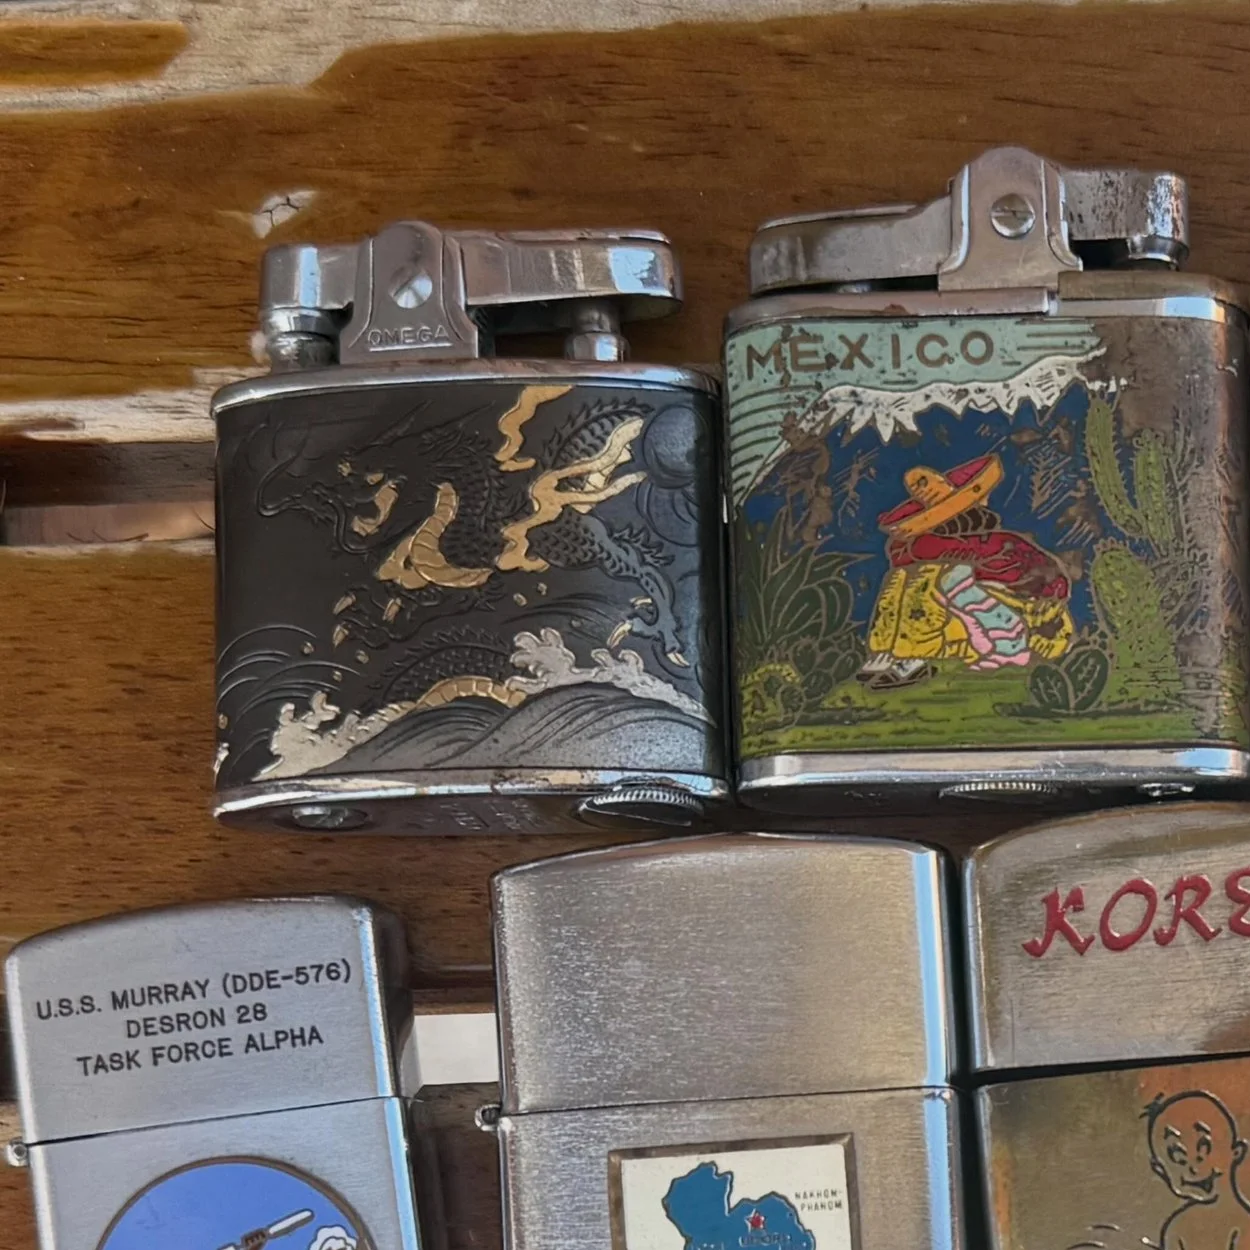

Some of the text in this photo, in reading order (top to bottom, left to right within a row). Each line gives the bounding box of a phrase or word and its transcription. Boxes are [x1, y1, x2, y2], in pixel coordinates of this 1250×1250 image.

[367, 324, 450, 345] OMEGA
[746, 330, 994, 381] MEXICO
[37, 957, 352, 1020] U.S.S. MURRAY (DDE-576)
[126, 1001, 268, 1039] DESRON 28
[77, 1024, 325, 1077] TASK FORCE ALPHA
